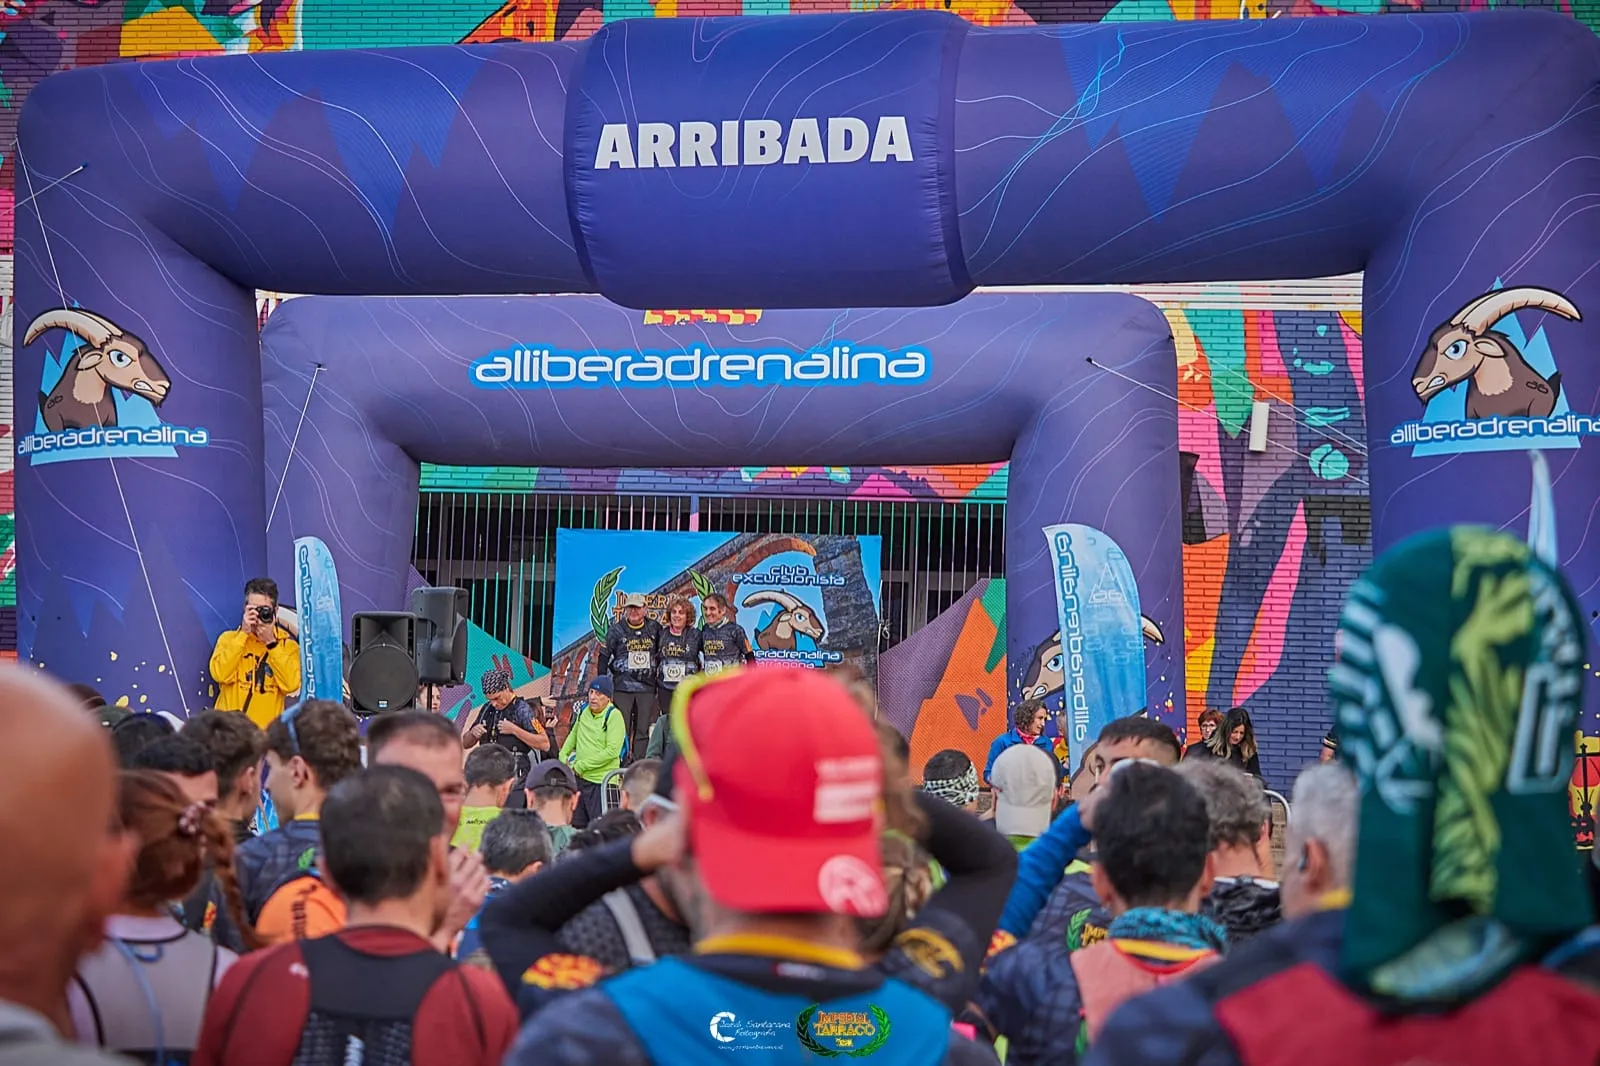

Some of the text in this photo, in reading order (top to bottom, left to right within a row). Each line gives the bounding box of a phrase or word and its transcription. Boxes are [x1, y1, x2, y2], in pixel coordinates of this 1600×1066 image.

[594, 116, 914, 169] ARRIBADA
[475, 346, 926, 382] alliberadrenalina
[18, 426, 207, 454] alliberadrenalina
[732, 574, 845, 585] excursionista
[771, 565, 807, 576] club
